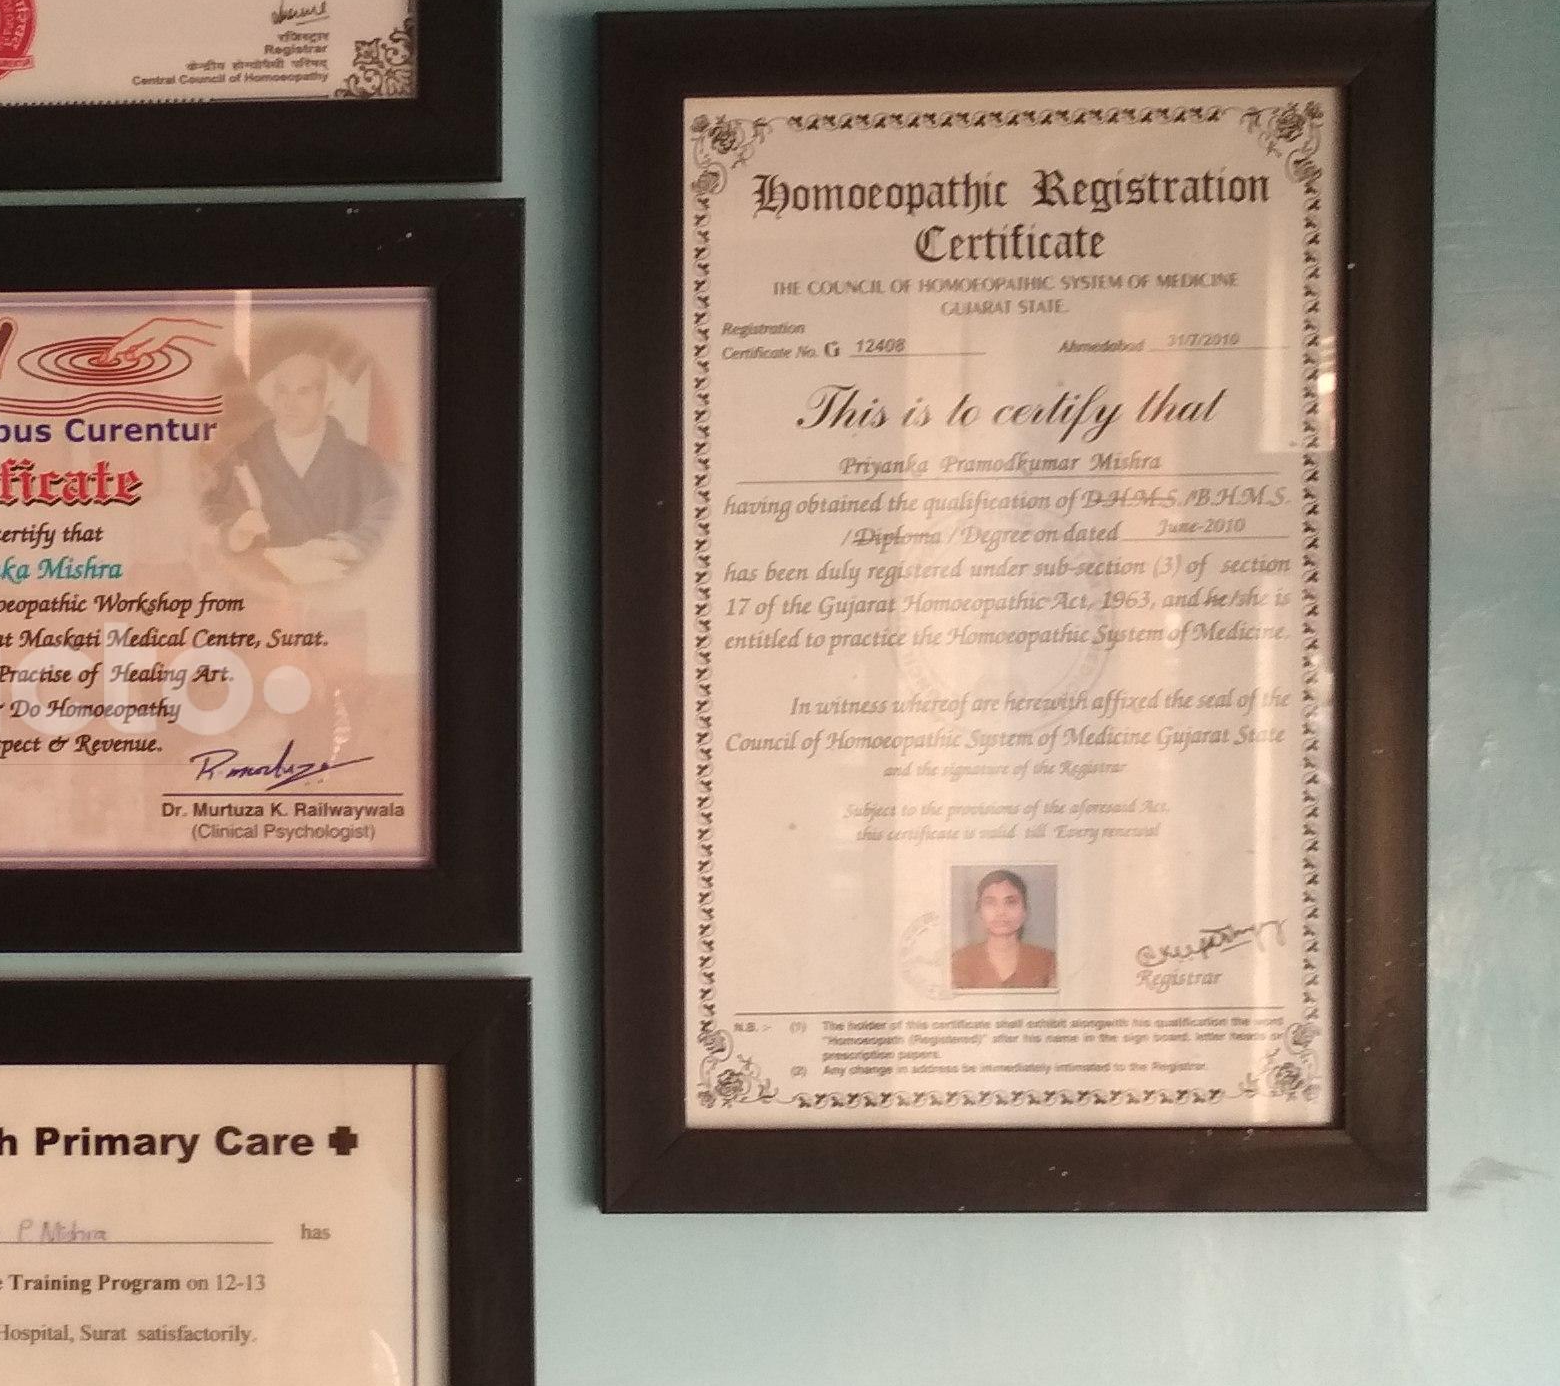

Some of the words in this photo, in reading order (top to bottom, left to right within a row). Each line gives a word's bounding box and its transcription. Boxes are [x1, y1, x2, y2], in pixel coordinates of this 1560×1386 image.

[264, 43, 328, 56] Registrar
[132, 75, 176, 86] Central
[178, 74, 227, 85] Council
[229, 72, 242, 83] of
[244, 71, 329, 84] Homoeopathy
[753, 172, 1007, 217] Homoeopathic
[1032, 167, 1269, 214] Registration
[915, 223, 1105, 262] Certificate
[774, 281, 800, 296] THE
[807, 279, 885, 295] COUNCIL
[890, 278, 911, 294] OF
[918, 276, 1055, 293] HOMOEOPATHIC
[1060, 275, 1123, 290] SYSTEM
[1127, 274, 1149, 289] OF
[1156, 273, 1237, 288] MEDICINE
[721, 321, 806, 339] Registration
[721, 346, 793, 360] Certificate
[795, 346, 818, 358] No.
[824, 340, 840, 357] G
[1058, 339, 1145, 353] Ahmedabad
[796, 384, 888, 430] This
[901, 397, 931, 427] is
[947, 393, 979, 428] to
[992, 385, 1124, 443] certify
[1136, 382, 1228, 422] that
[65, 418, 219, 444] Curentur
[838, 453, 928, 481] Priyanka
[940, 450, 1081, 480] Pramodkumar
[1089, 449, 1162, 478] Mishra
[62, 522, 104, 542] that
[37, 555, 123, 579] Mishra
[93, 591, 193, 619] Workshop
[194, 591, 245, 618] from
[19, 627, 102, 651] Maskati
[107, 626, 190, 647] Medical
[192, 629, 261, 648] Centre,
[266, 629, 328, 648] Surat.
[48, 735, 70, 753] &
[74, 734, 162, 756] Revenue.
[162, 802, 187, 817] Dr.
[192, 801, 265, 818] Murtuza
[269, 801, 289, 817] K.
[293, 801, 406, 823] Railwaywala
[191, 823, 258, 841] (Clinical
[263, 822, 376, 843] Psychologist)
[35, 1127, 200, 1163] Primary
[215, 1126, 314, 1156] Care
[300, 1223, 331, 1240] has
[8, 1274, 92, 1295] Training
[98, 1274, 181, 1295] Program
[186, 1279, 208, 1290] on
[217, 1274, 265, 1291] 12-13
[80, 1324, 127, 1341] Surat
[137, 1325, 257, 1346] satisfactorily.
